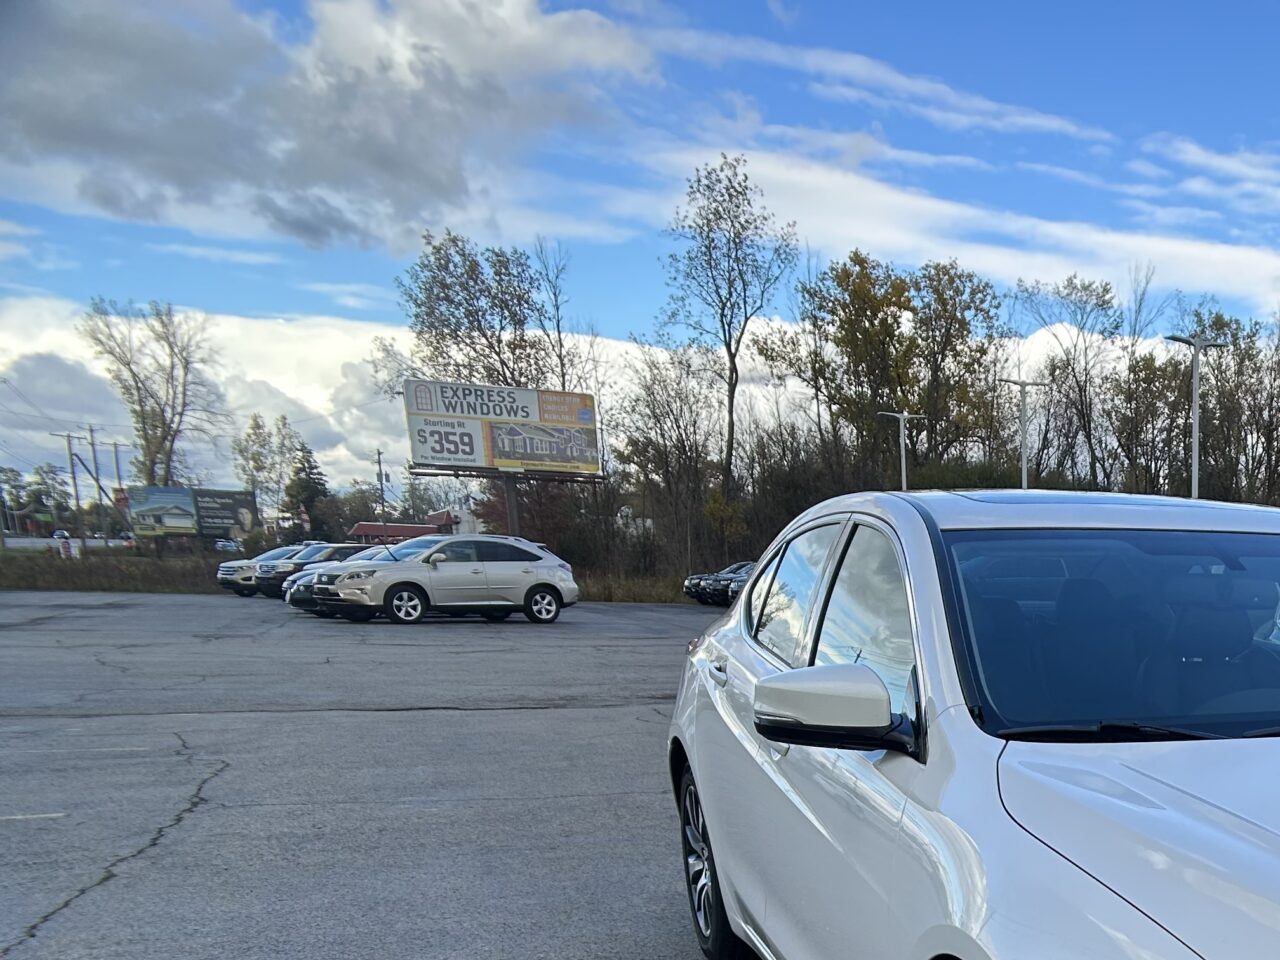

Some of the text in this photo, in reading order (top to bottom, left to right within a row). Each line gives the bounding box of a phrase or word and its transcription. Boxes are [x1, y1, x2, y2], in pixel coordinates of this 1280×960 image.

[440, 385, 517, 404] EXPRESS
[441, 399, 530, 418] WINDOWS
[423, 418, 465, 429] Starting At
[417, 428, 475, 456] $359
